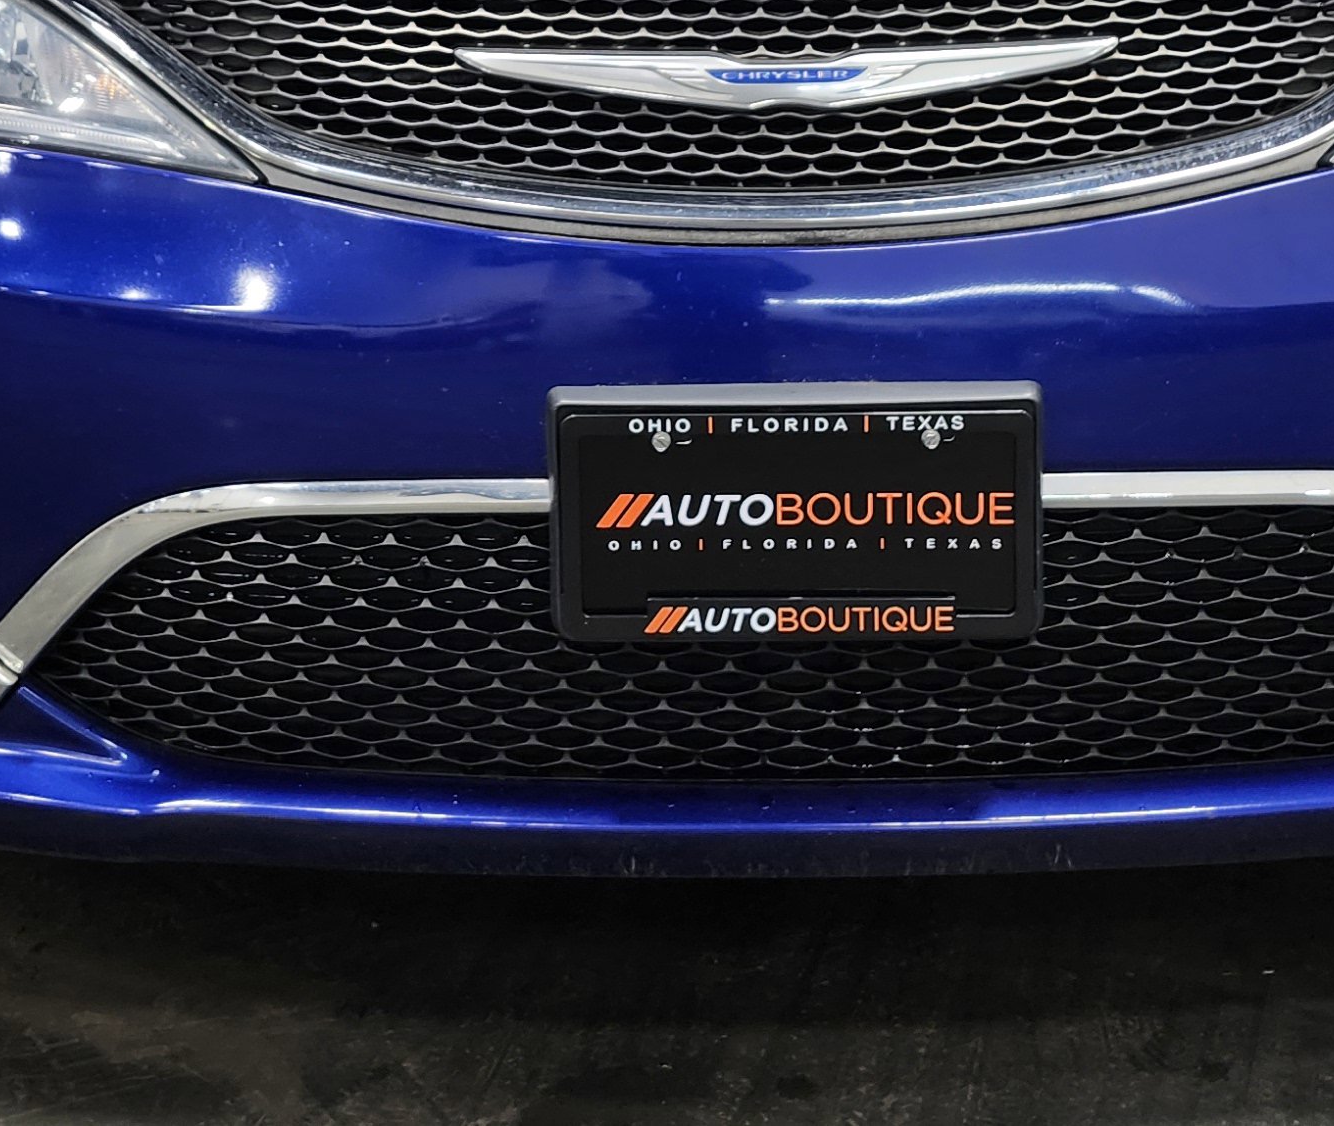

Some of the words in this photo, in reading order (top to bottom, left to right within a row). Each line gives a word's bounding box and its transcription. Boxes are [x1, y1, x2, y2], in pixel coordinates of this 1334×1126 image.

[721, 70, 849, 80] CHRYSLER
[628, 417, 692, 434] OHIO
[730, 416, 850, 433] FLORIDA
[886, 415, 965, 432] TEXAS
[641, 492, 1016, 527] AUTOBOUTIQUE
[608, 539, 682, 551] OHIO
[722, 538, 858, 551] FLORIDA
[904, 537, 1003, 550] TEXAS
[677, 605, 955, 634] AUTOBOUTIQUE
